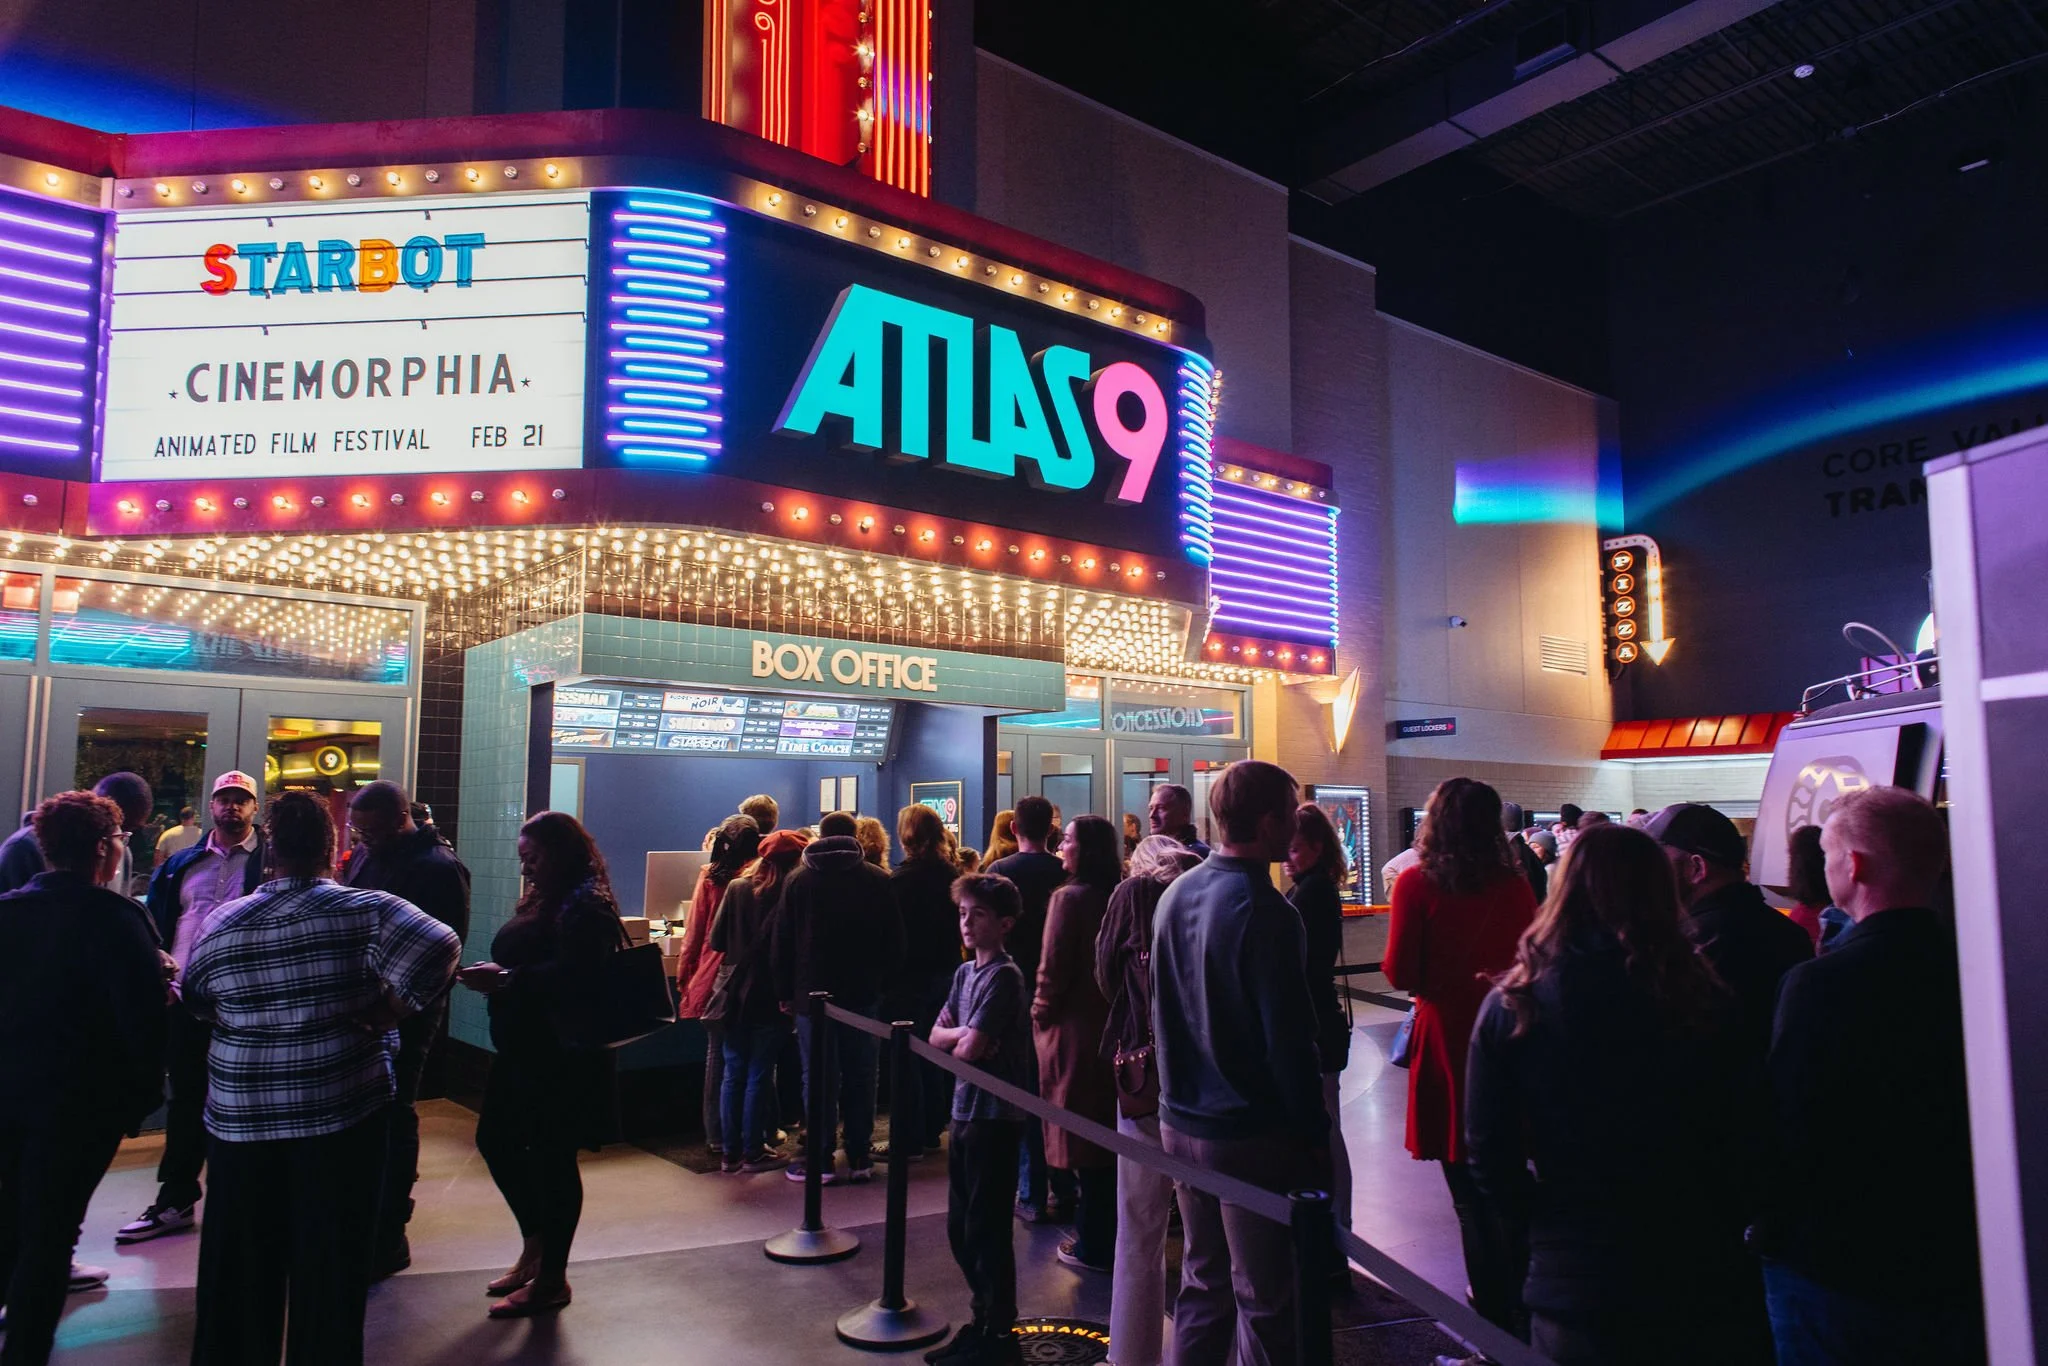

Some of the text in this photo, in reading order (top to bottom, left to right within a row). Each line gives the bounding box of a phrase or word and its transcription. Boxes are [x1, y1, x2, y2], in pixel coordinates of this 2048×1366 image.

[200, 233, 485, 296] STARBOT
[185, 353, 516, 403] CINEMORPHIA
[154, 424, 543, 457] ANIMATED FILM FESTIVAL FEB 21
[1822, 436, 1928, 479] CORE
[1612, 553, 1636, 660] PIZZA
[752, 639, 938, 692] BOX OFFICE
[690, 696, 719, 711] NOIR
[1110, 707, 1204, 732] ONCESSIONS
